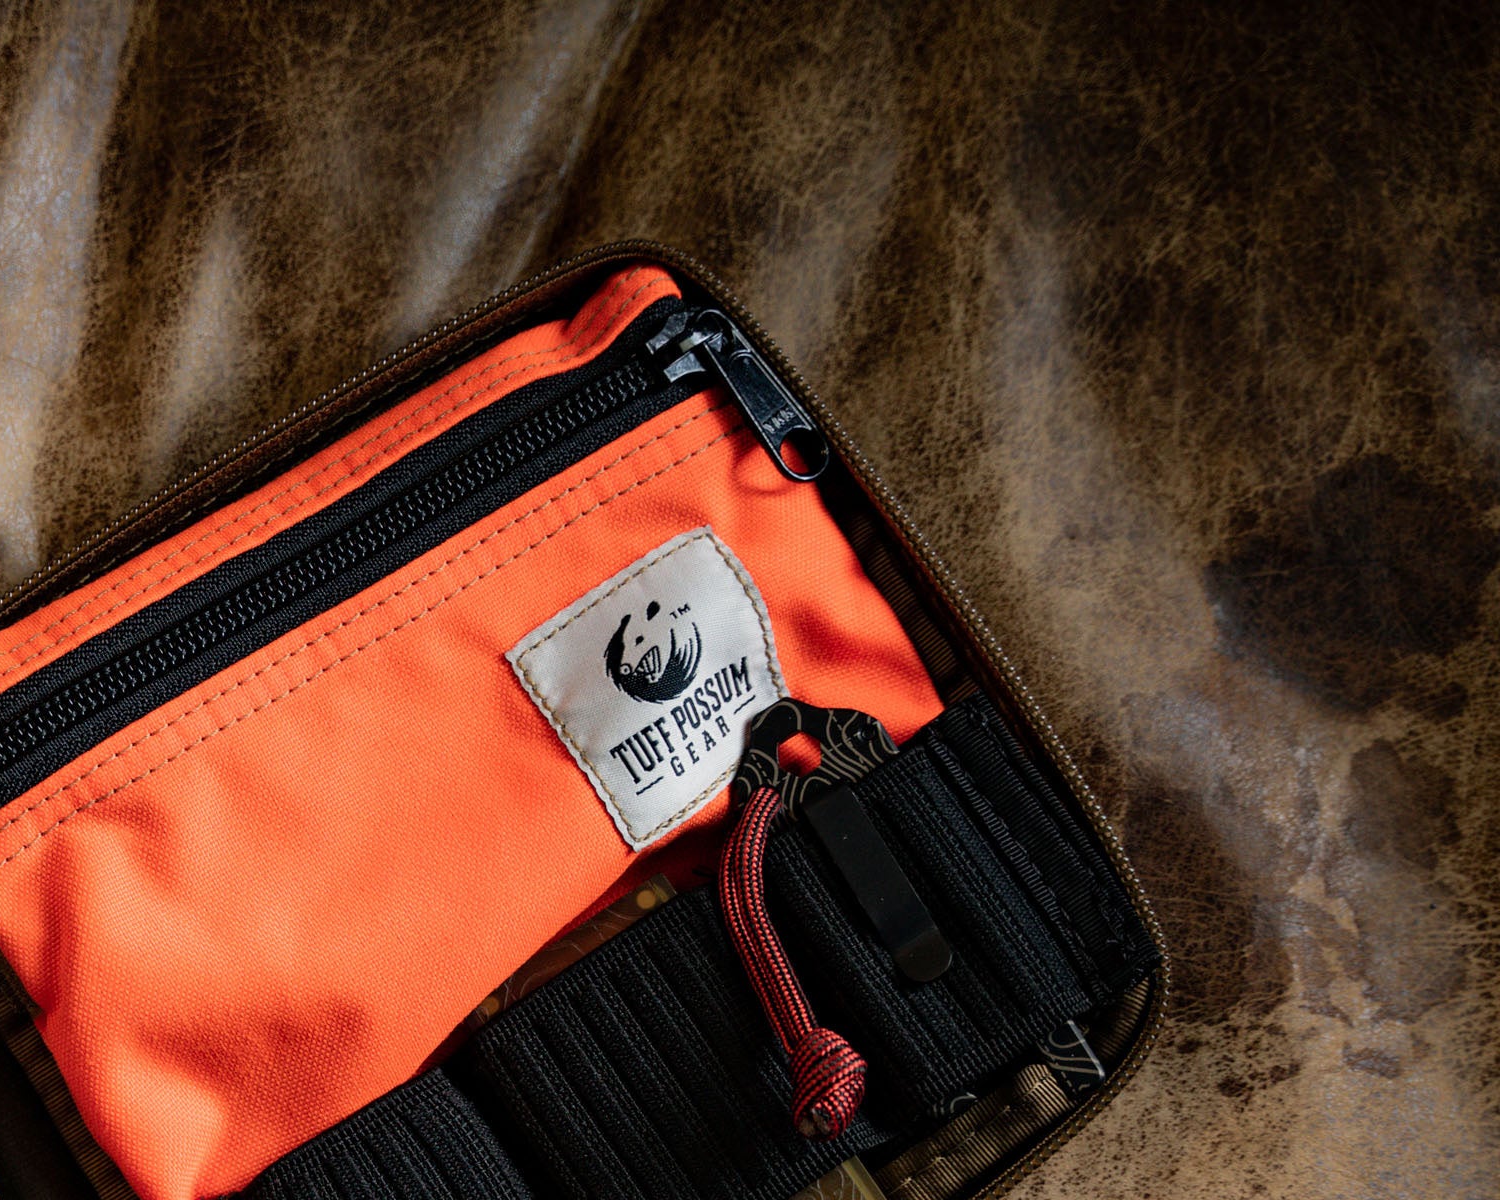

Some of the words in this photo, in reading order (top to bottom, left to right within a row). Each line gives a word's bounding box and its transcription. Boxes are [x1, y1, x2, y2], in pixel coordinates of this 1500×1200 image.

[670, 604, 691, 619] TM
[609, 716, 675, 784] TUFF
[670, 656, 753, 741] POSSUM
[670, 715, 731, 777] GEAR
